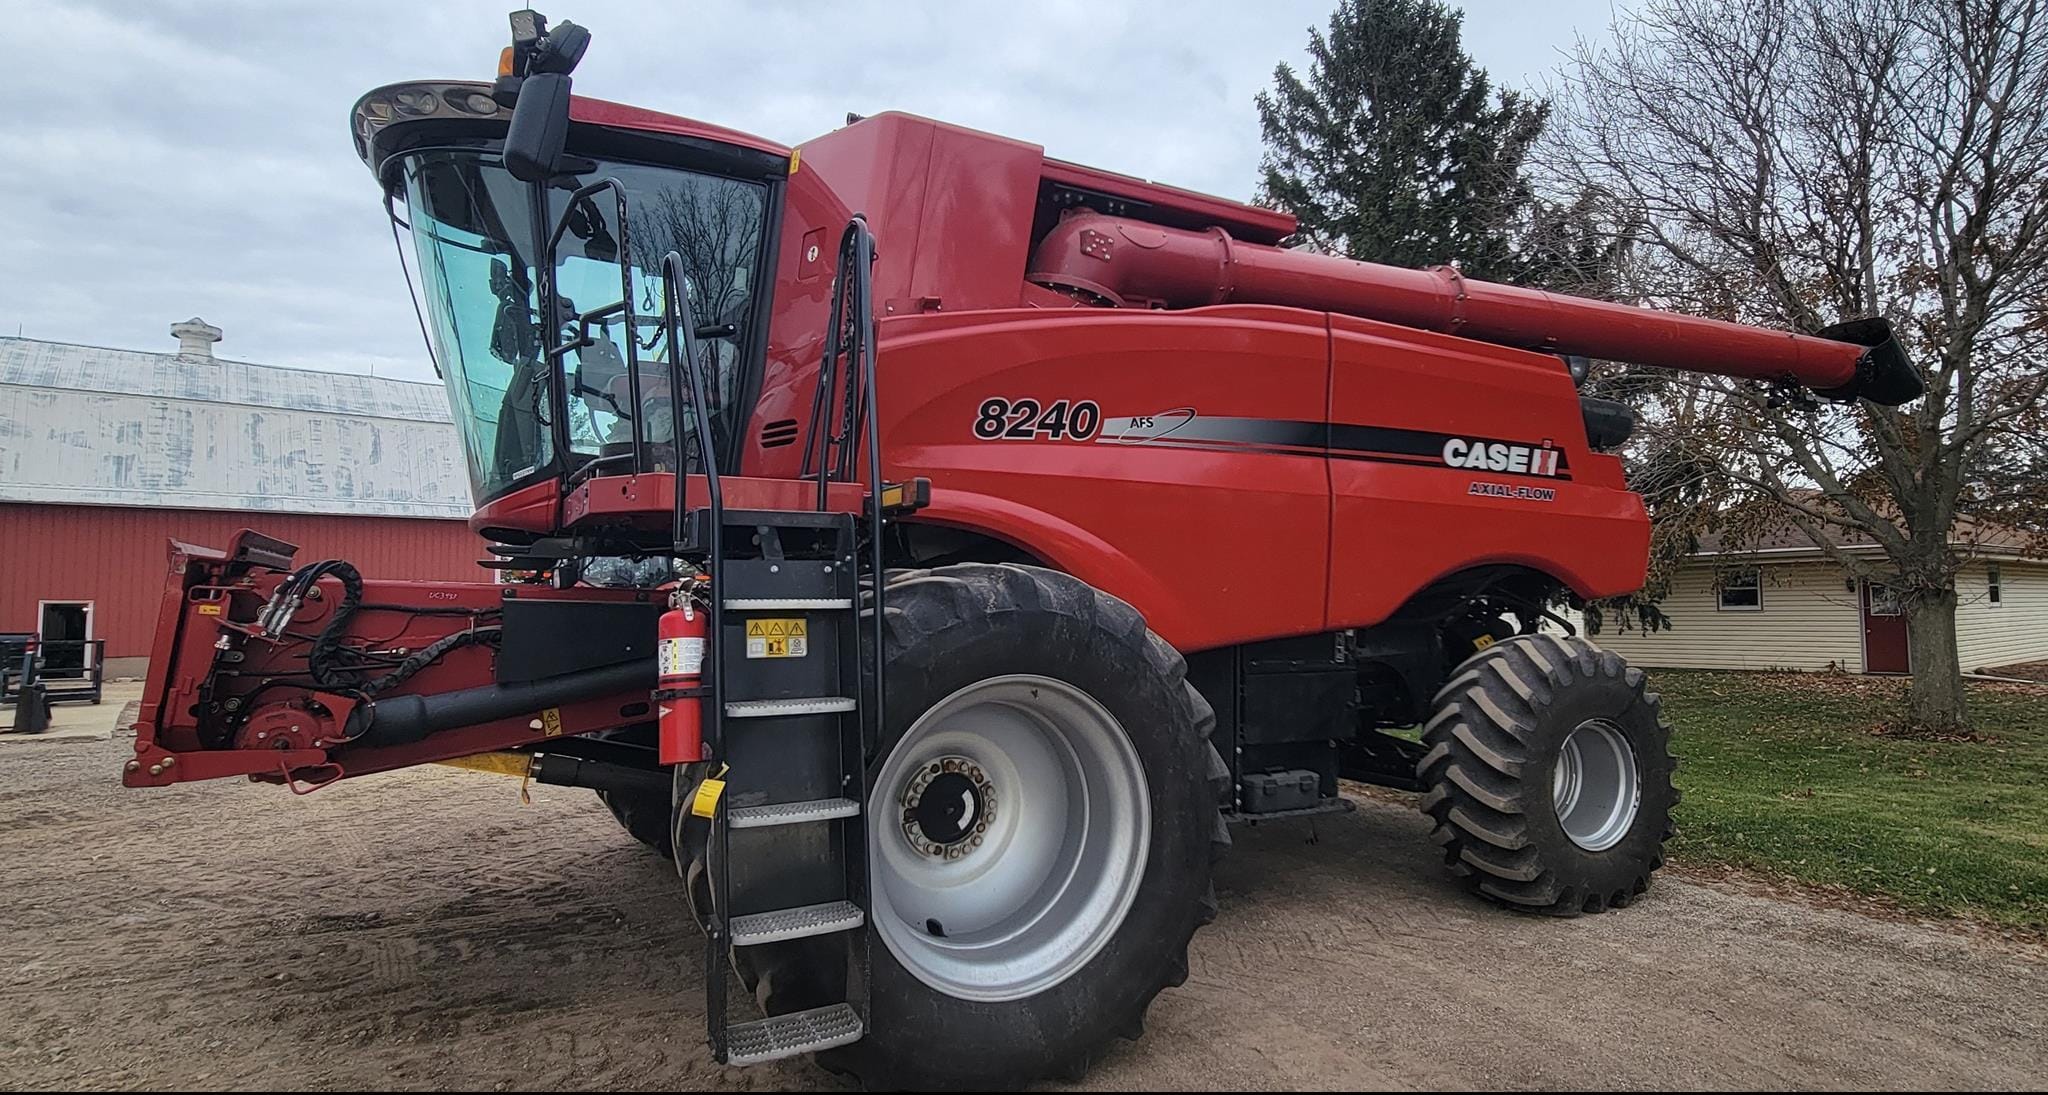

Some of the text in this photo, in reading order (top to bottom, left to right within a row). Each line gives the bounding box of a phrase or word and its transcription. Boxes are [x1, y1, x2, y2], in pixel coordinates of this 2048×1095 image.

[974, 397, 1100, 440] 8240
[1130, 417, 1154, 428] AFS
[1443, 438, 1529, 473] CASE
[1468, 482, 1555, 501] AXIAL-FLOW
